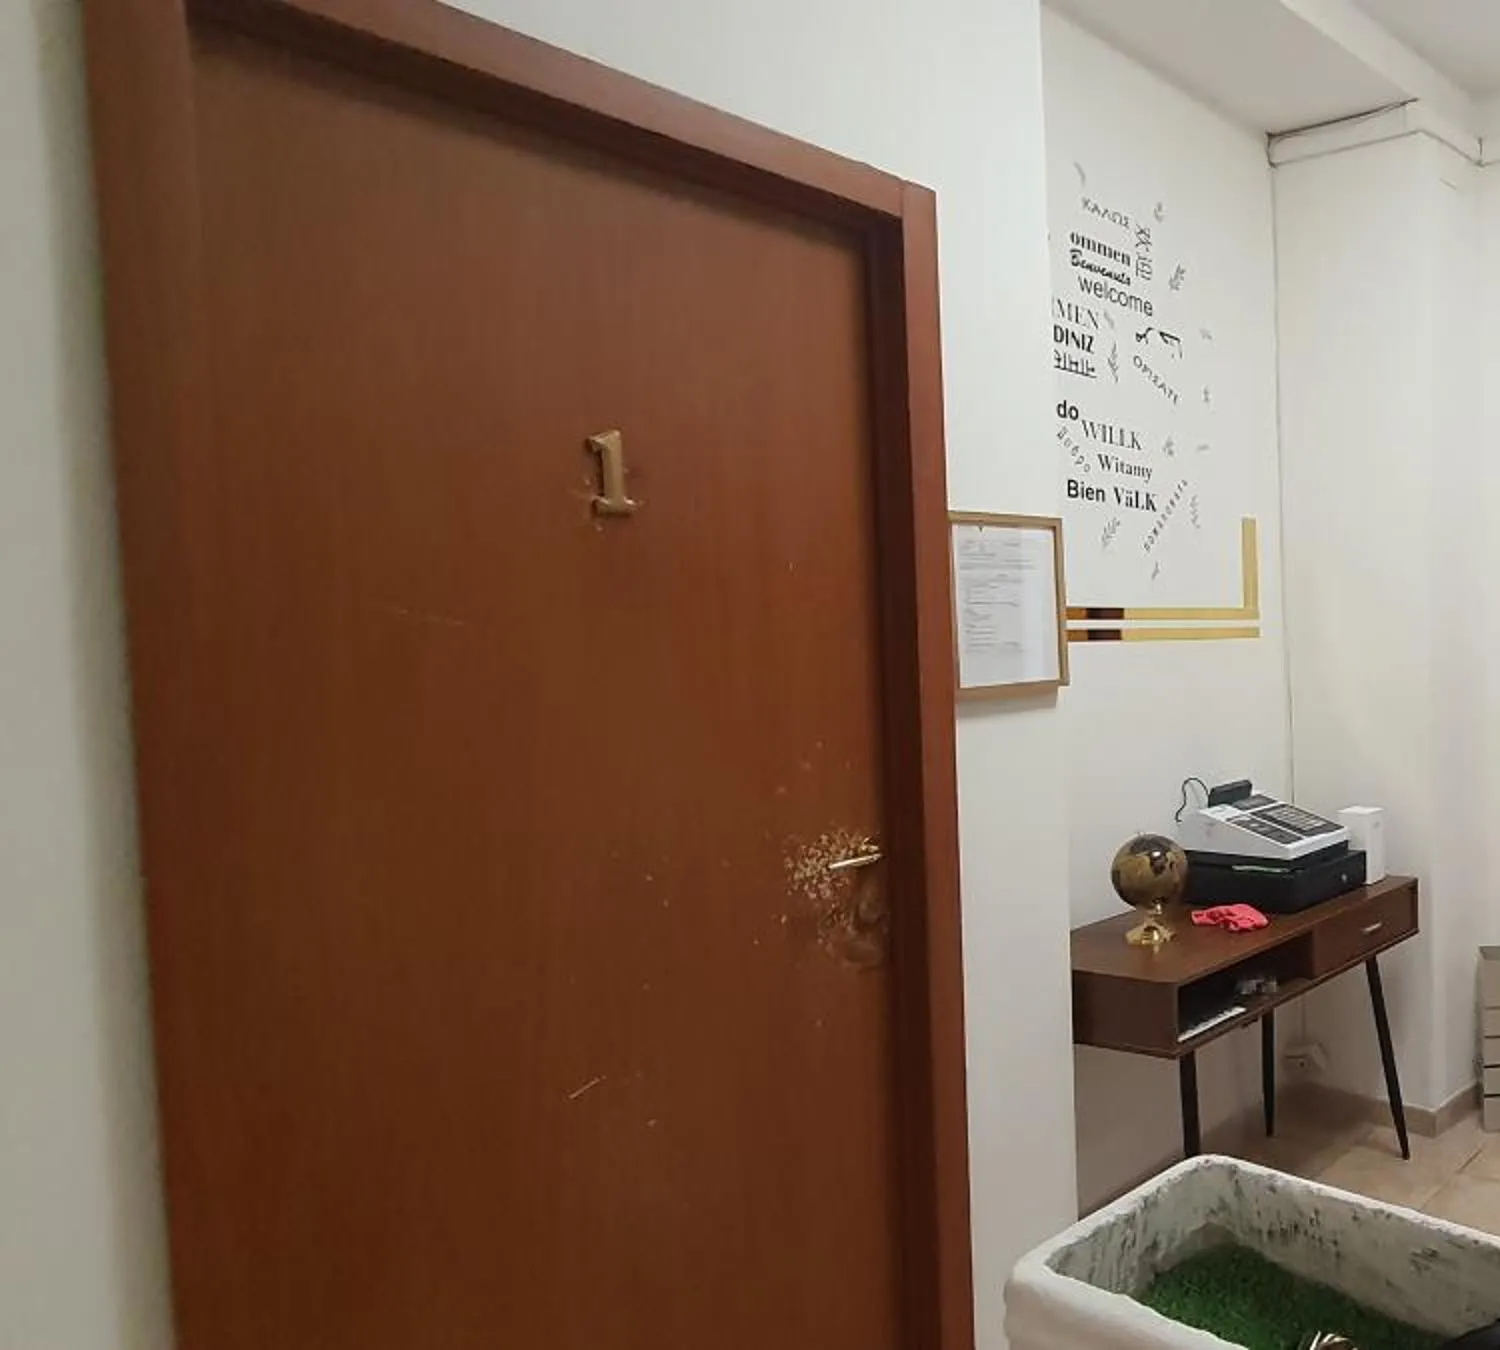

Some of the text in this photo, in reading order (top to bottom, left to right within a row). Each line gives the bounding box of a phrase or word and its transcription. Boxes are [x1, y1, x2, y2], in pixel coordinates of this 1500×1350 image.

[1077, 275, 1153, 316] welcome
[1056, 400, 1079, 420] do
[1081, 419, 1143, 450] WILLK
[585, 429, 638, 516] 1
[1097, 453, 1153, 484] Witamy
[1067, 479, 1106, 503] Bien
